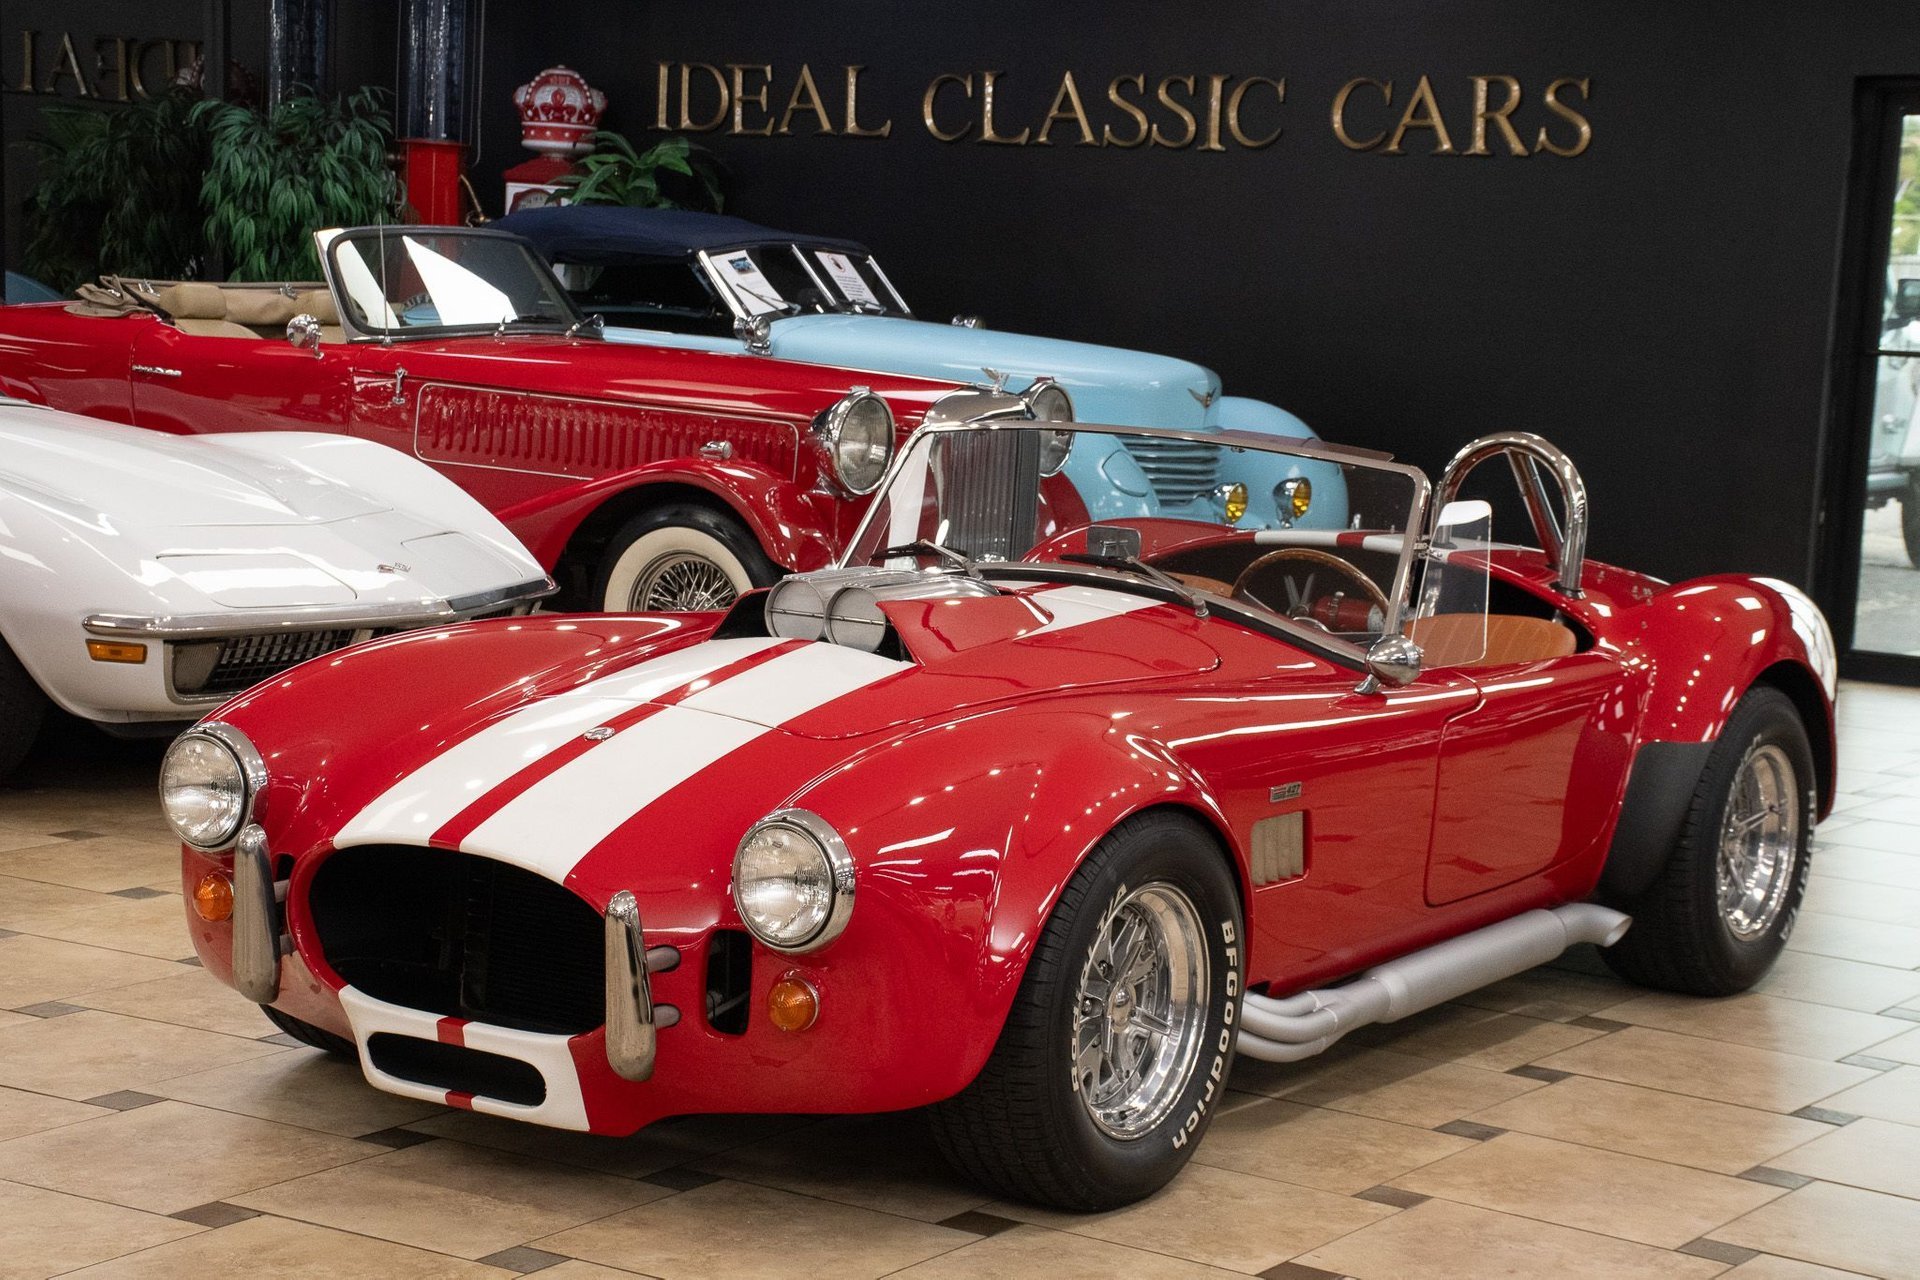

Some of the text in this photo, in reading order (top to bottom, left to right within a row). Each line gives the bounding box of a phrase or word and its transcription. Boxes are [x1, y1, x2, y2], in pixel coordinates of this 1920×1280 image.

[648, 61, 1593, 158] IDEAL CLASSIC CARS
[1172, 921, 1236, 1150] BFGoodrich
